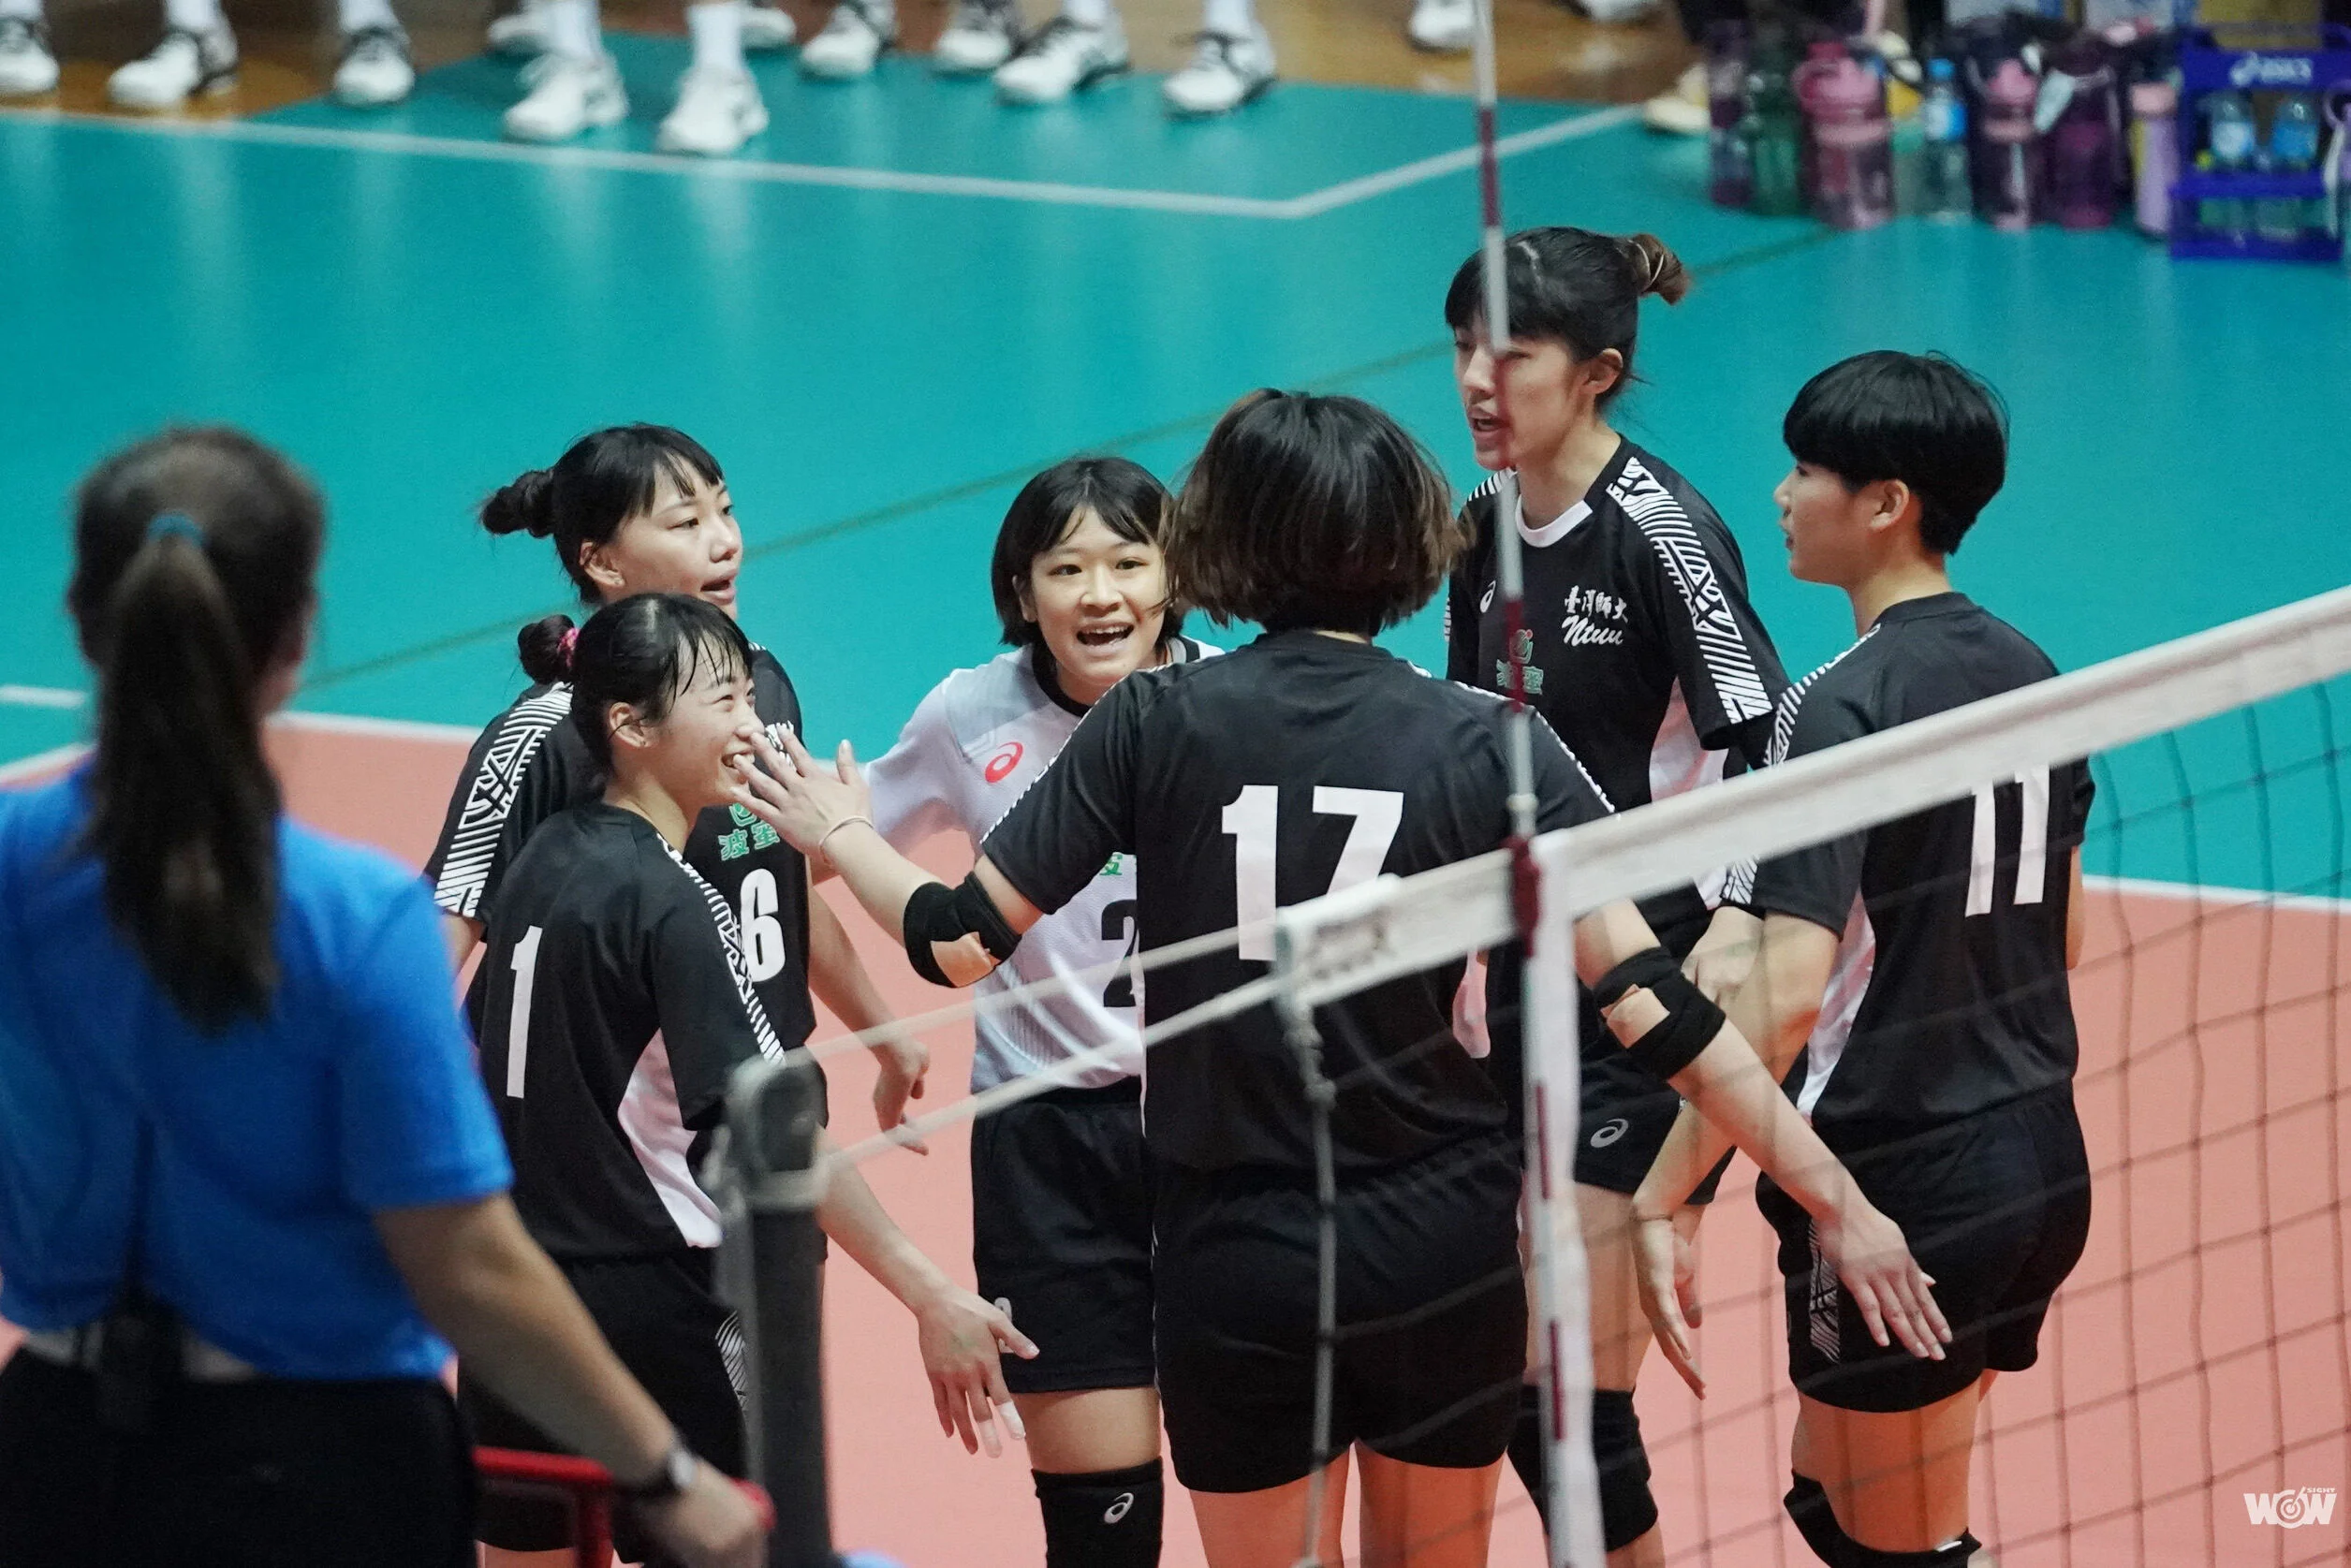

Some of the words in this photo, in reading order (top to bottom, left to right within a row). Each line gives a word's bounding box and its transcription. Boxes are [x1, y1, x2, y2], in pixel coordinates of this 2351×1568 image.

[1222, 784, 1403, 961] 17
[1965, 760, 2050, 917] 11
[740, 868, 786, 983] 6
[507, 925, 543, 1099] 1
